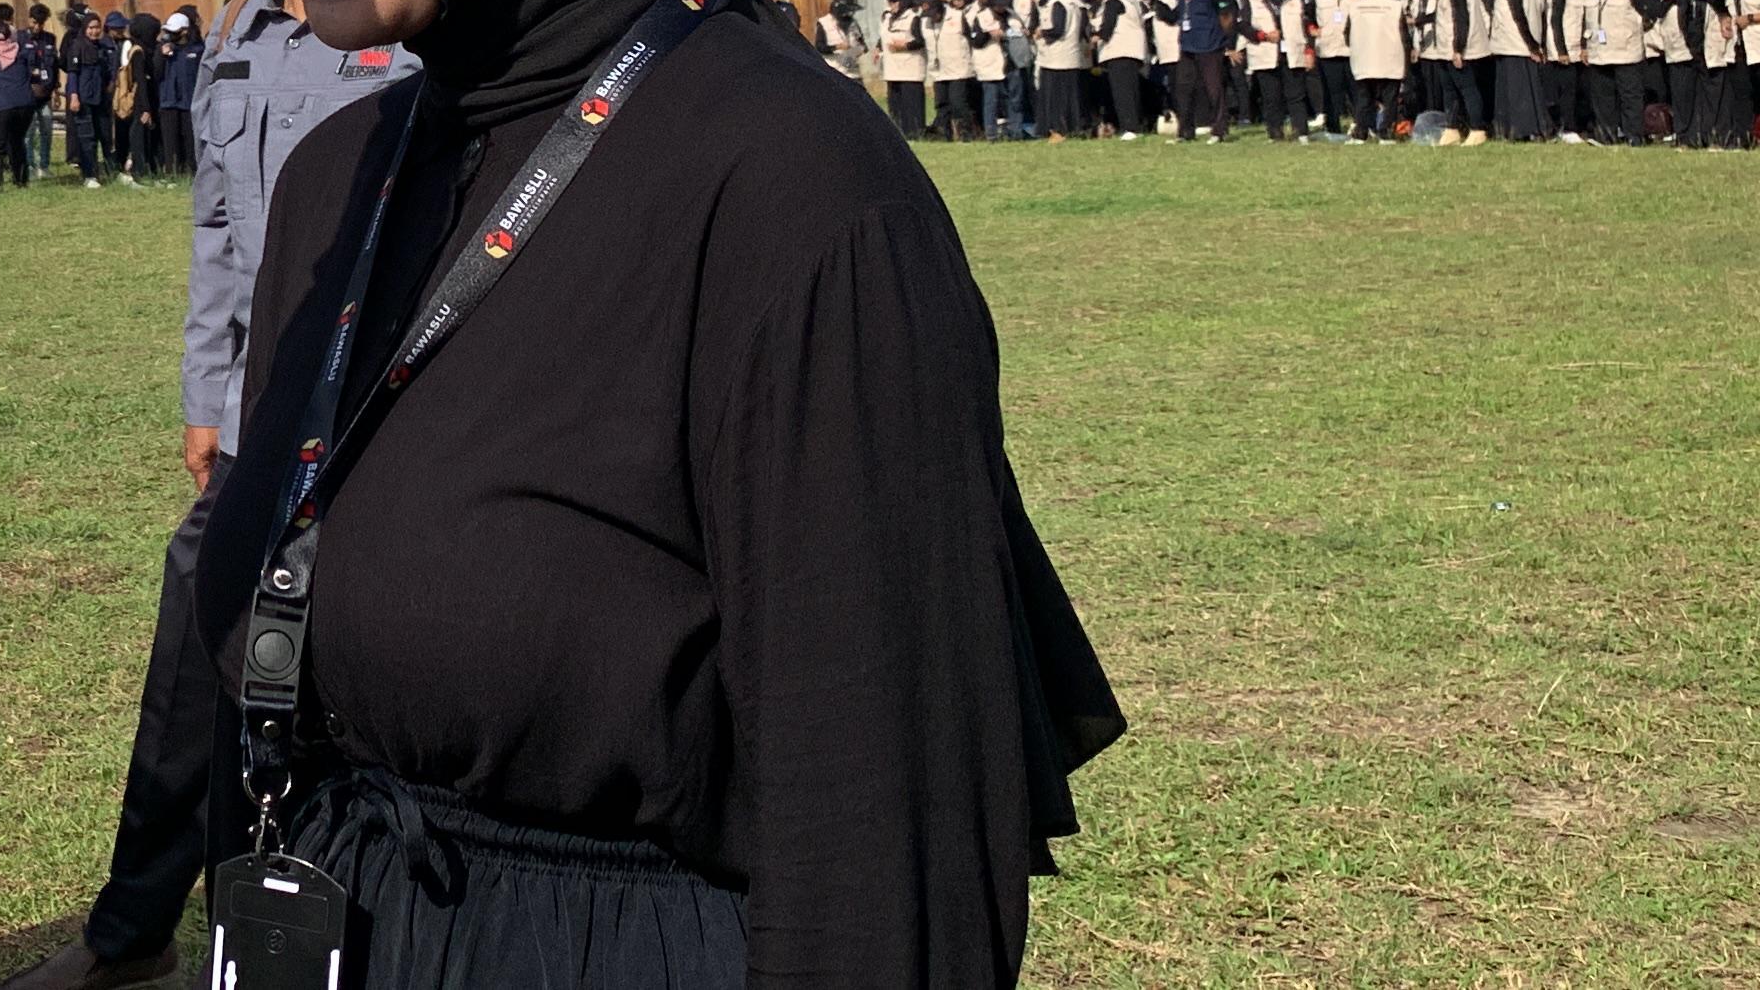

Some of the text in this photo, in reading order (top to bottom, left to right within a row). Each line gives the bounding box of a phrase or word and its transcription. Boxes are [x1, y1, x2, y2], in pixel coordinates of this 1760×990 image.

[344, 65, 387, 78] BERSAMA
[595, 41, 646, 97] BAWASLU
[499, 168, 548, 230] BAWASLU
[327, 322, 350, 382] BAWASLU
[404, 303, 451, 364] BAWASLU
